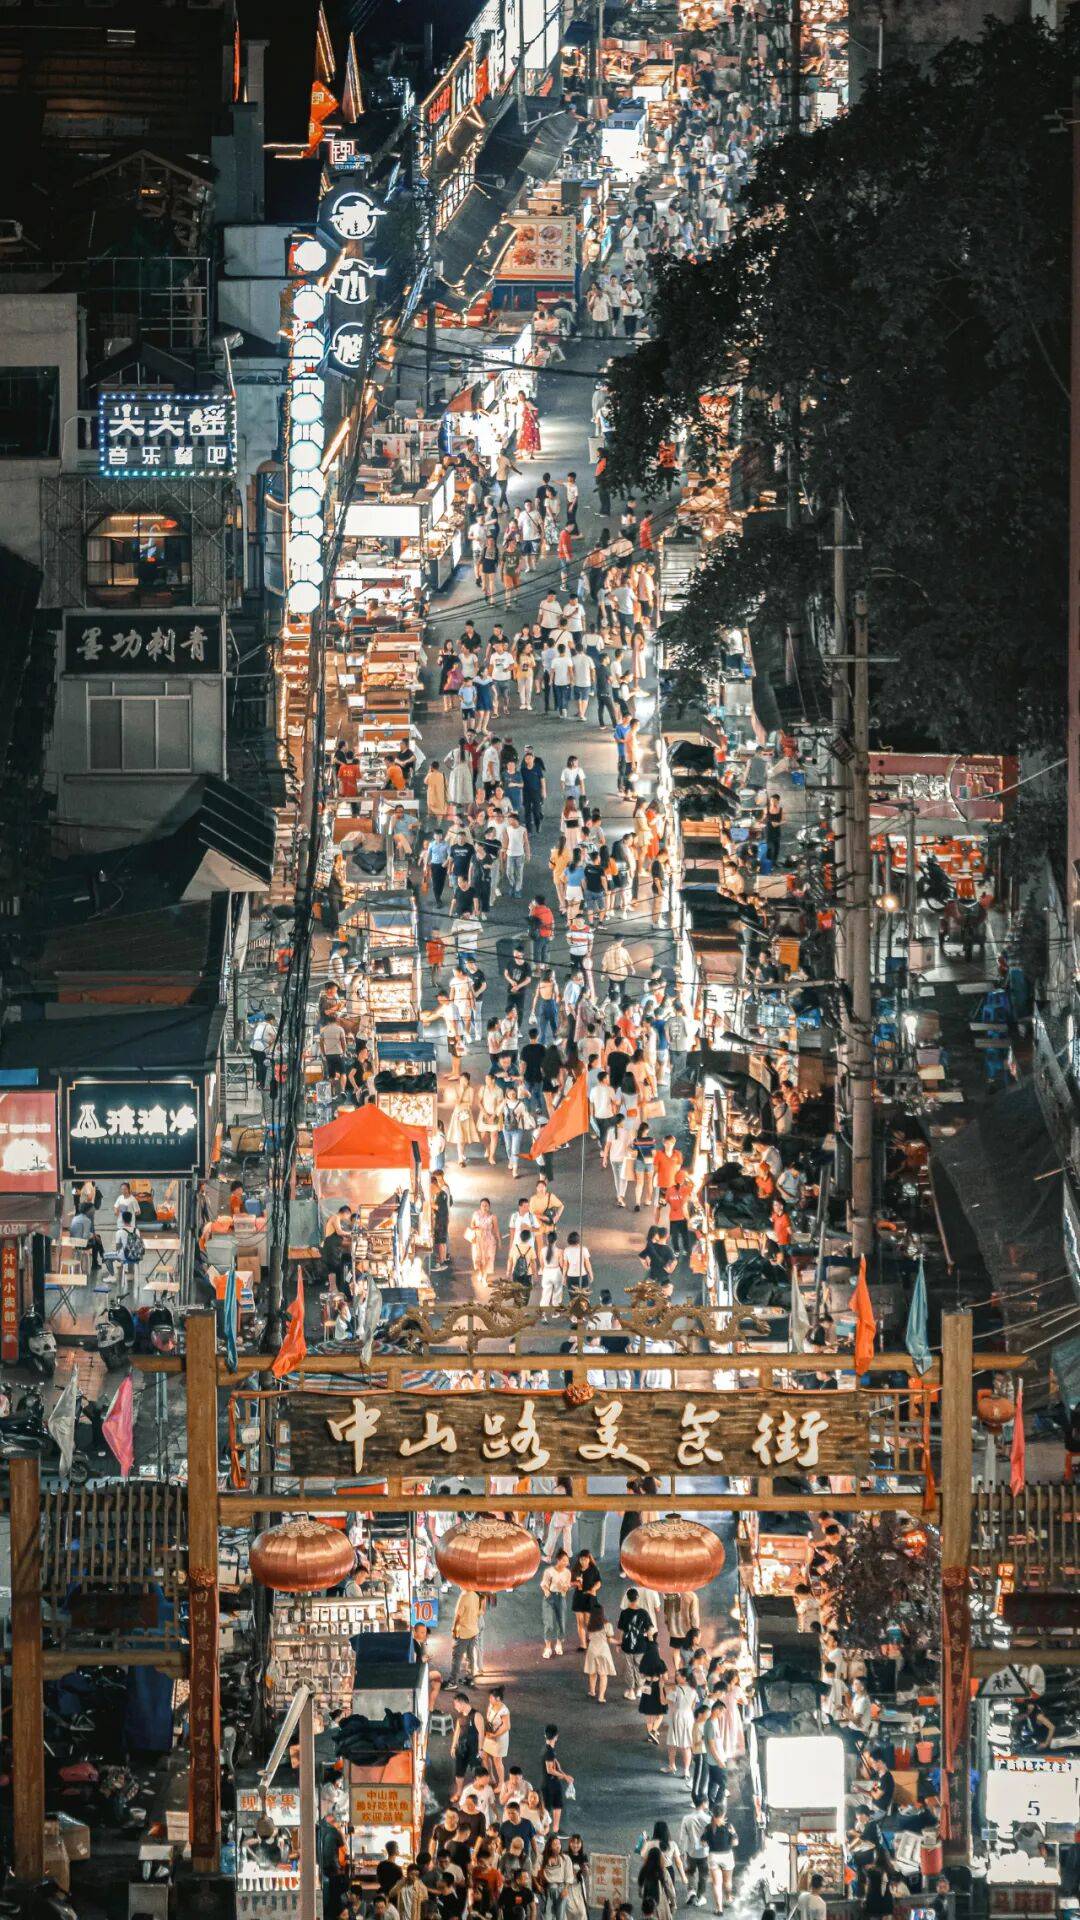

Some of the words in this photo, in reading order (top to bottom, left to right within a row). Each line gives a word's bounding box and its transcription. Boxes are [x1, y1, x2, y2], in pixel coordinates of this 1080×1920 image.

[109, 446, 227, 464] 音乐餐吧
[76, 625, 209, 662] 墨功刺青
[326, 1397, 830, 1474] 中山路美食街
[414, 1601, 433, 1621] 10
[1027, 1800, 1041, 1816] 5
